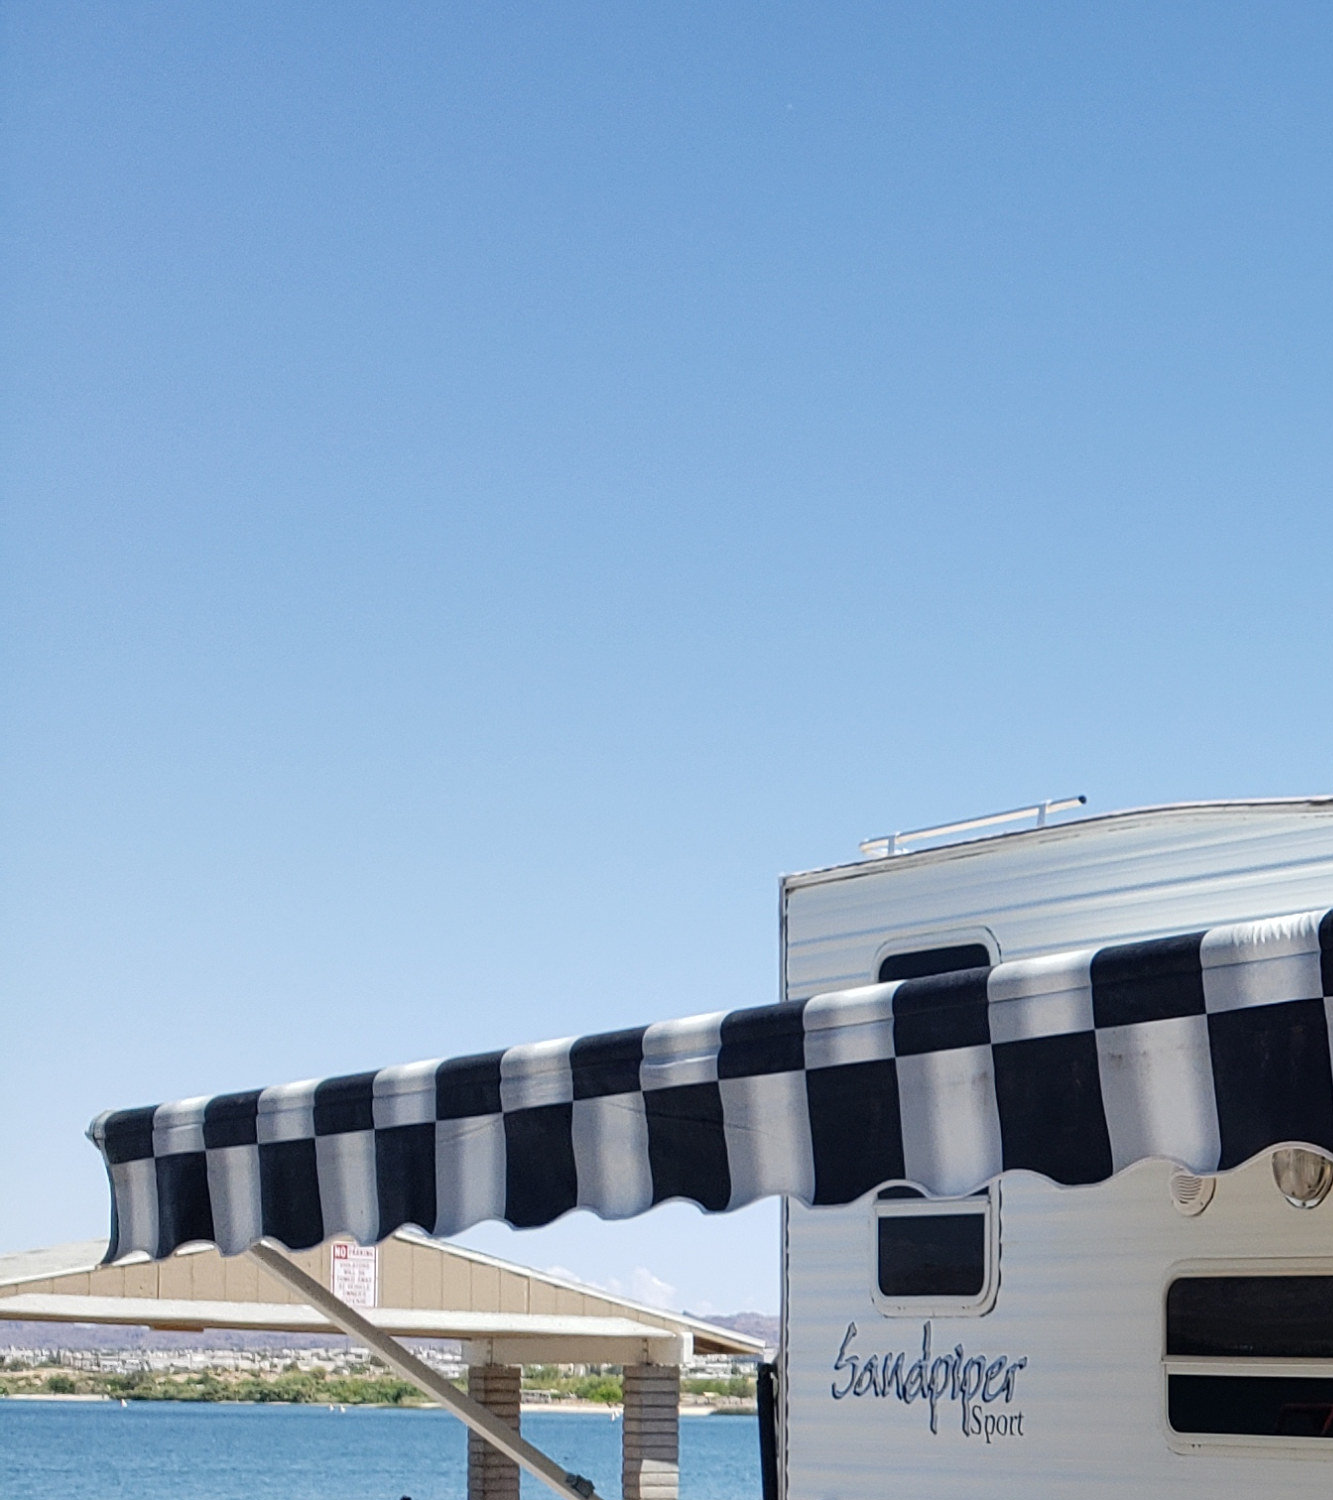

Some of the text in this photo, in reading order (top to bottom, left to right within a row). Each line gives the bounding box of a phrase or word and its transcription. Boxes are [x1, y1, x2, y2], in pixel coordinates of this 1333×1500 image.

[335, 1245, 347, 1257] NO
[831, 1320, 1028, 1438] Sandpiper
[970, 1405, 1024, 1444] Sport
